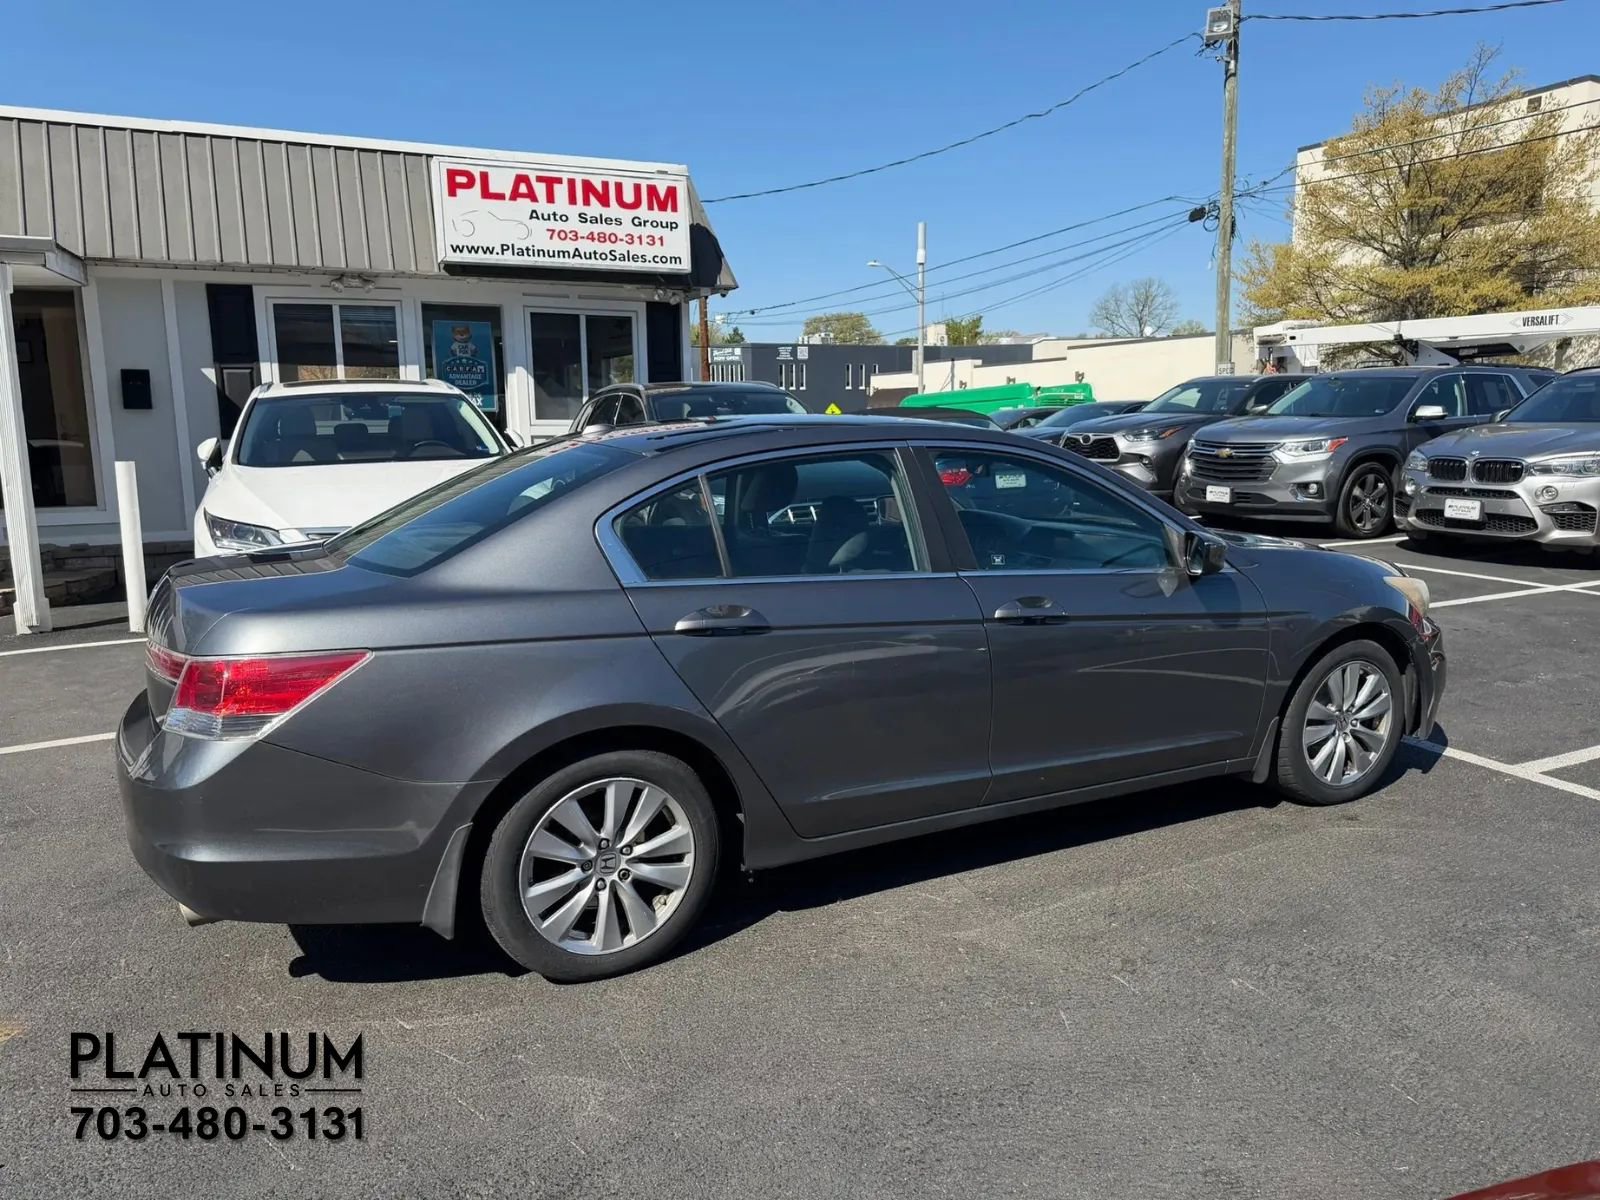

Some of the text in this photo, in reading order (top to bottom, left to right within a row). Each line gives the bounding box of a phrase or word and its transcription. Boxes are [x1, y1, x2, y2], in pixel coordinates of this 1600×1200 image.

[446, 168, 678, 213] PLATINUM
[528, 209, 679, 231] Auto Sales Group
[546, 228, 665, 247] 703-480-3131
[450, 243, 682, 265] www.PlatinumAutoSales.com
[1522, 314, 1559, 327] VERSALIFT
